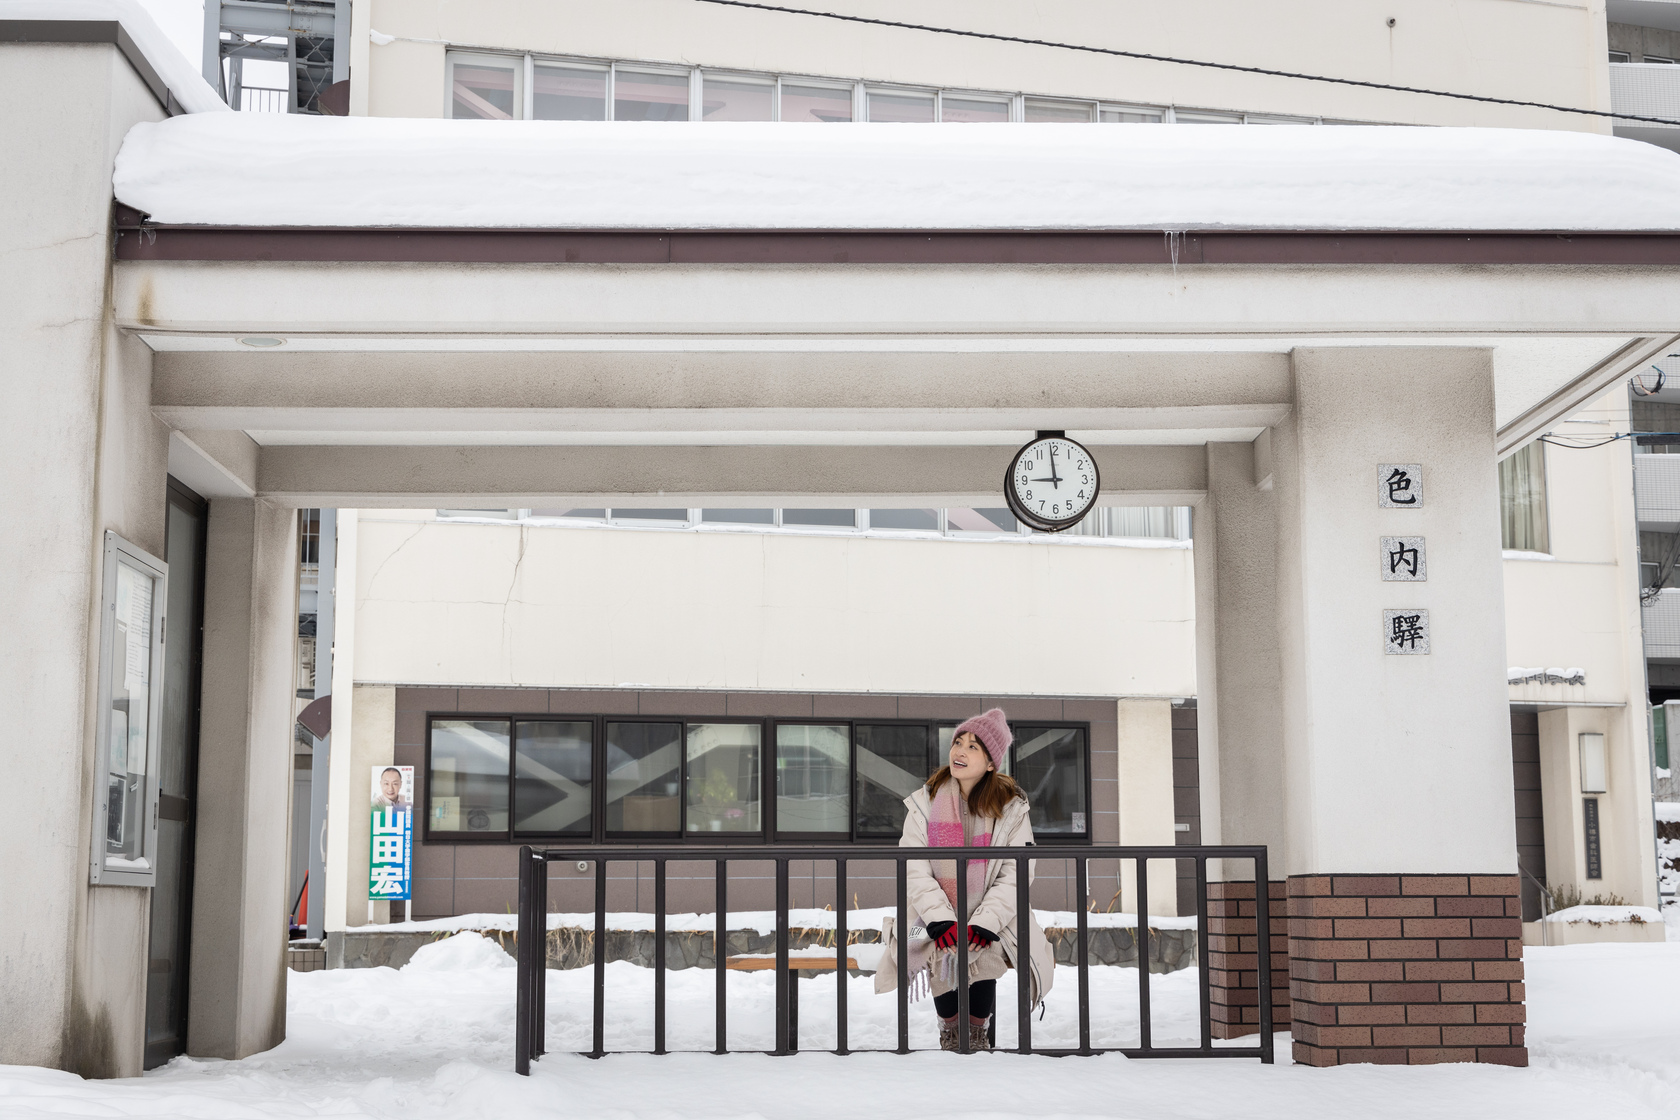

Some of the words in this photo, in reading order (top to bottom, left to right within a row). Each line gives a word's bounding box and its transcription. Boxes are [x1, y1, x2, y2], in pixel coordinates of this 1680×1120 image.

[1036, 449, 1043, 460] 11
[1024, 460, 1034, 471] 10
[1076, 459, 1084, 470] 2
[1021, 475, 1028, 486] 9
[1081, 474, 1089, 485] 3
[1025, 489, 1033, 500] 8
[1077, 489, 1085, 500] 4
[1039, 500, 1046, 511] 7
[1052, 504, 1059, 515] 6
[1066, 500, 1073, 511] 5
[370, 805, 404, 895] 山田宏
